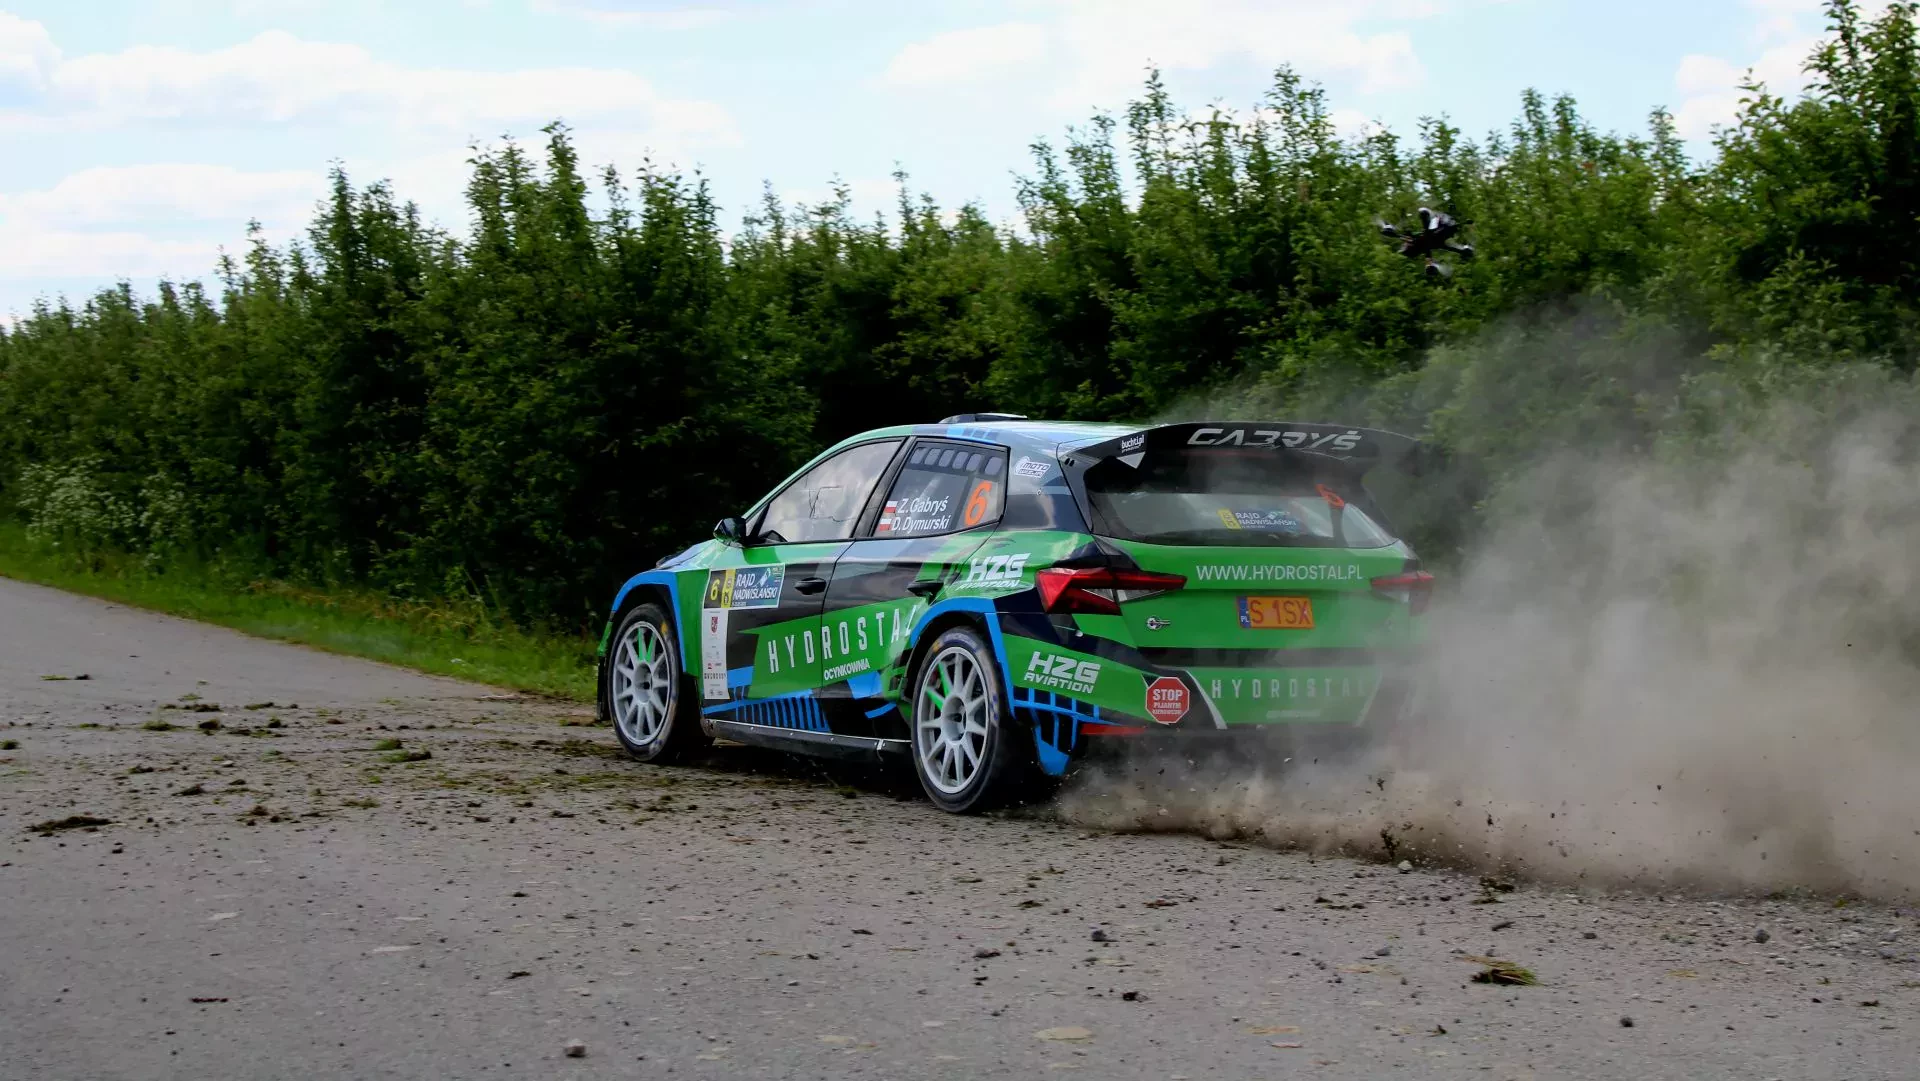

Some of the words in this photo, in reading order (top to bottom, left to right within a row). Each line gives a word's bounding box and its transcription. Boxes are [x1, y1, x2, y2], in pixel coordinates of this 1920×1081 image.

[1022, 461, 1050, 471] MOTO
[964, 480, 993, 527] 6
[1235, 512, 1261, 520] RAJD
[966, 553, 1032, 583] HZG
[1196, 565, 1363, 580] WWW.HYDROSTAL.PL
[710, 579, 720, 600] 6
[735, 573, 756, 588] RAJD
[1240, 615, 1249, 623] PL
[823, 658, 871, 680] OCYNKOWNIA
[1028, 651, 1100, 684] HZG
[1024, 672, 1094, 694] AVIATION
[1211, 678, 1367, 698] HYDROSTAL
[1152, 689, 1183, 701] STOP
